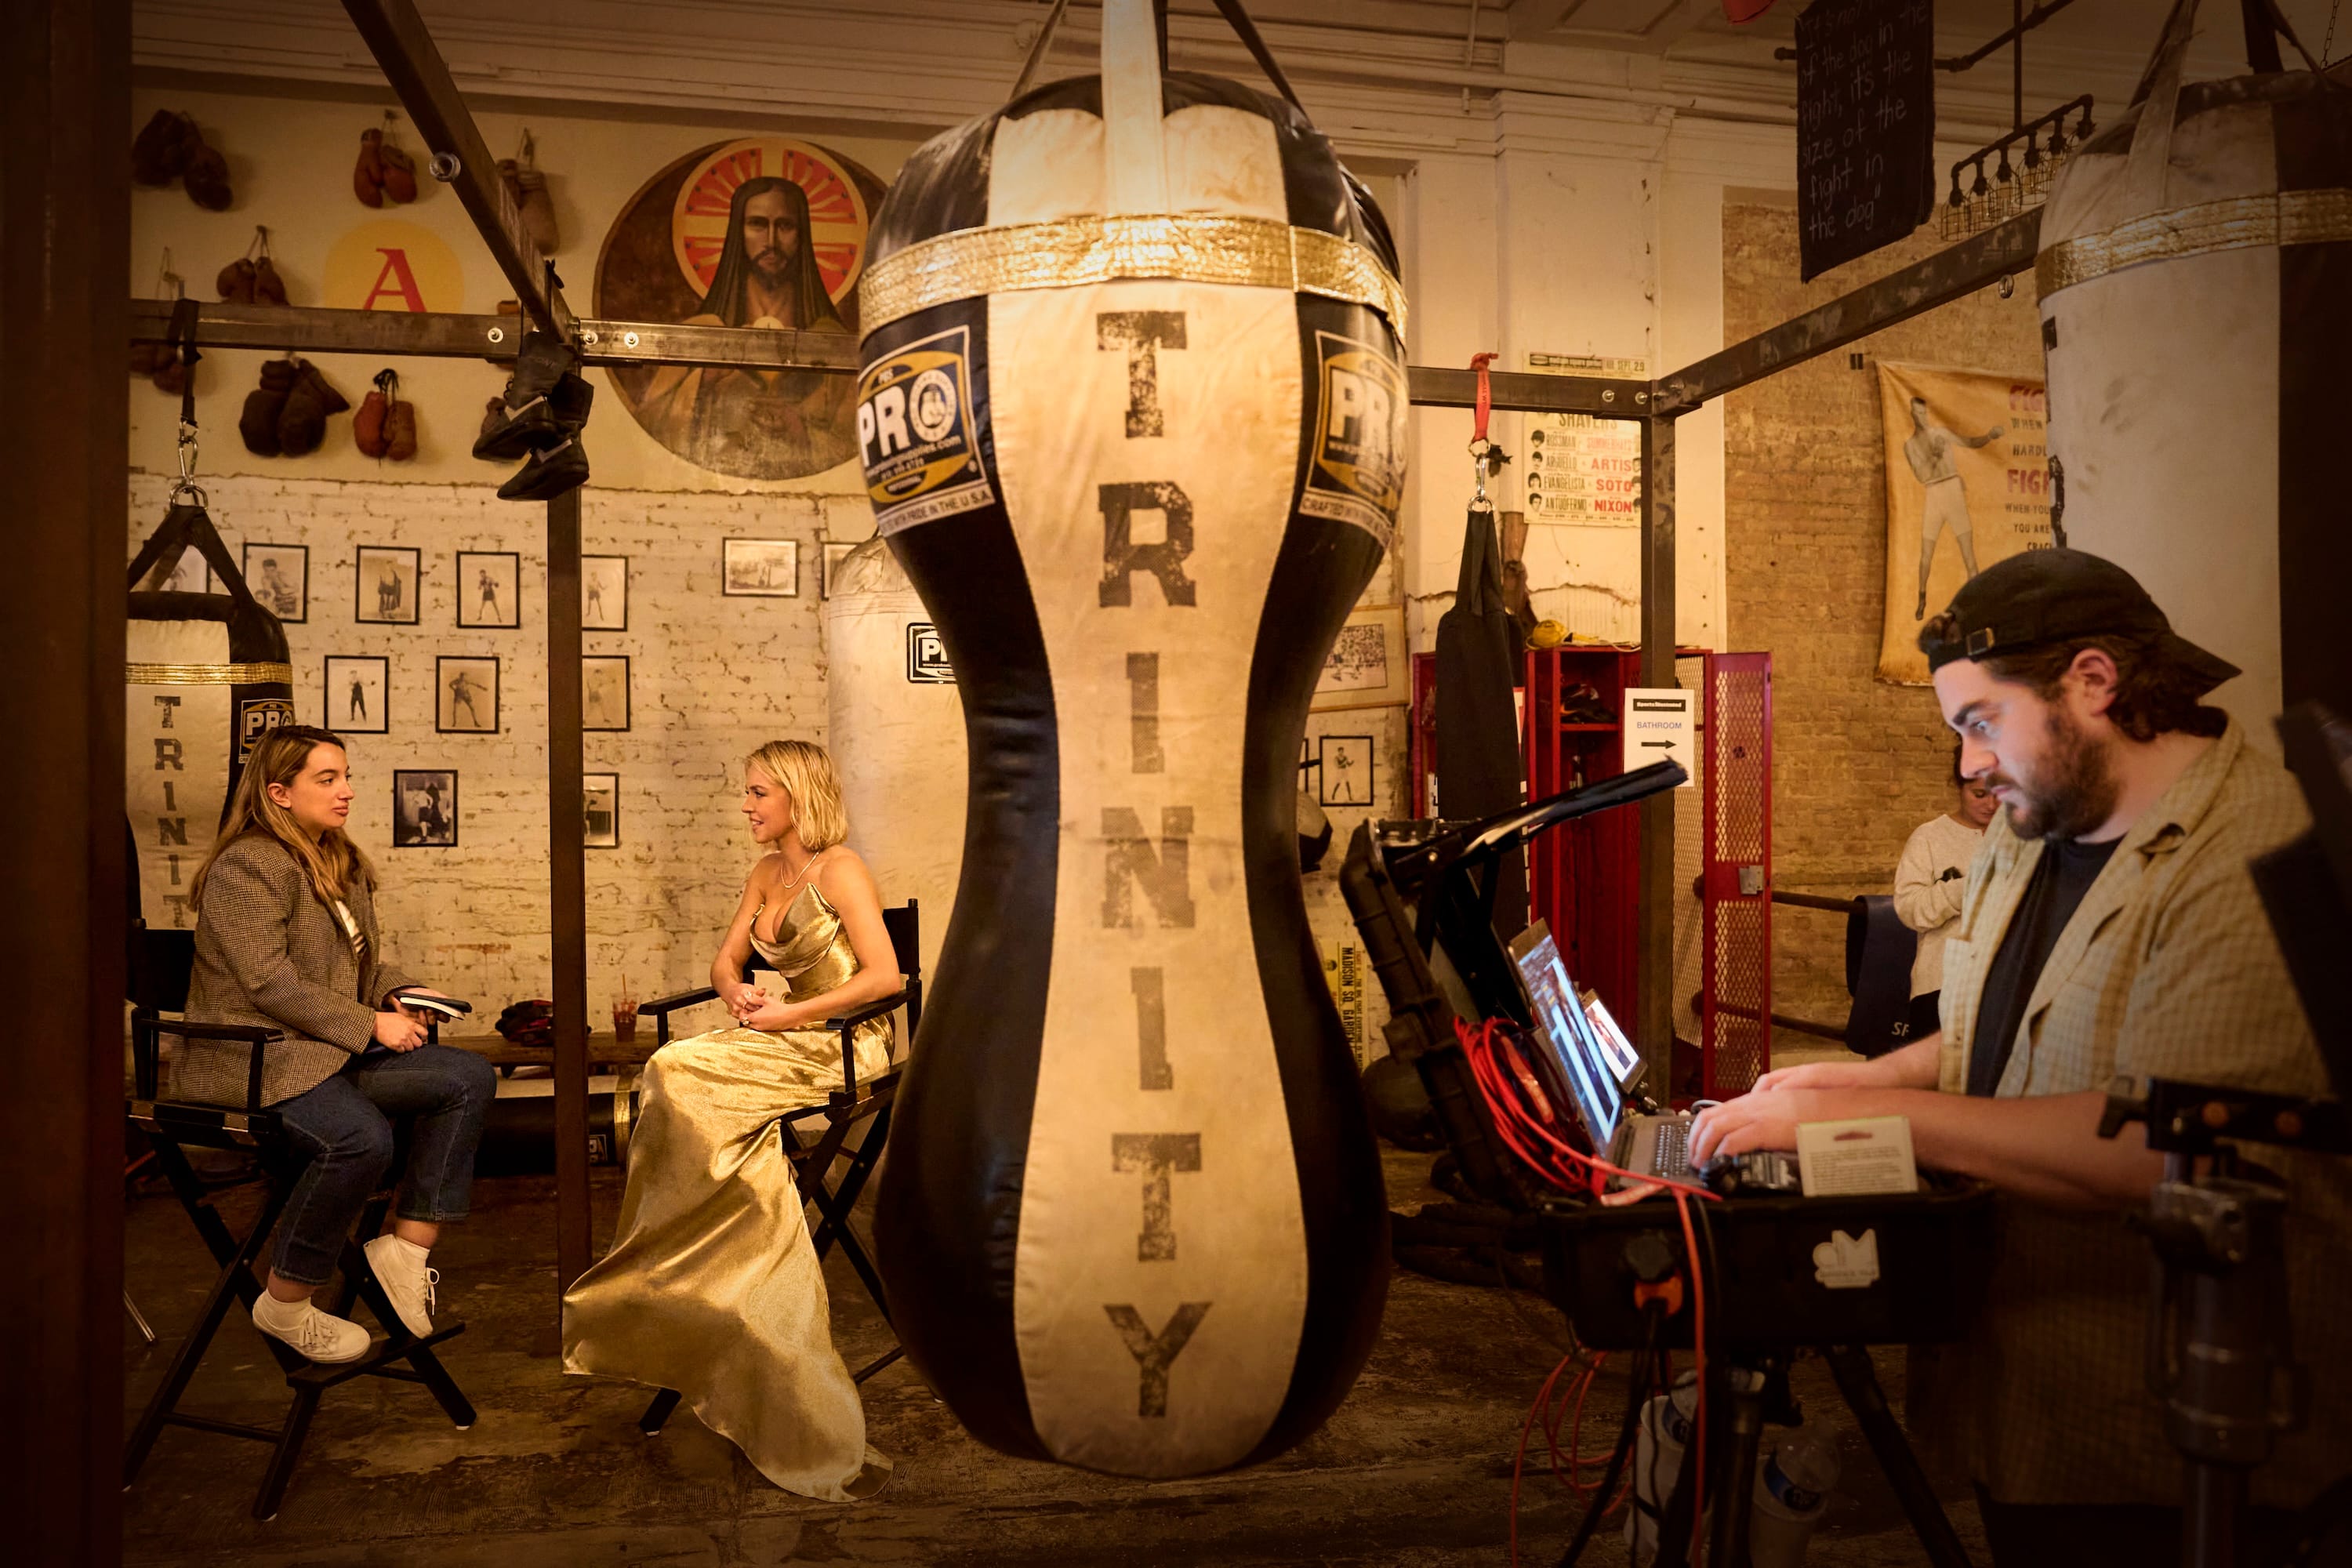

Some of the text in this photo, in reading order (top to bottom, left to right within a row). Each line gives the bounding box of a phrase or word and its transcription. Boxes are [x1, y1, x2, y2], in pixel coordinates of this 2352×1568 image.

[1822, 44, 1845, 78] the
[1849, 31, 1873, 66] dog
[1878, 19, 1893, 49] in
[1850, 63, 1875, 105] it's
[1882, 50, 1913, 85] the
[1802, 96, 1907, 169] size of the
[1809, 149, 1883, 212] fight in
[1808, 210, 1837, 242] the
[364, 248, 427, 312] A
[1634, 361, 1645, 372] 29
[2009, 384, 2045, 412] FIG
[858, 368, 957, 467] PRO
[2011, 418, 2043, 430] WHEN
[1592, 457, 1632, 472] ARTIS
[2013, 444, 2048, 457] HARDL
[1595, 478, 1632, 492] SOTO
[938, 499, 960, 513] THE
[1594, 499, 1632, 513] NIXON
[2013, 523, 2050, 534] YOU ARE
[1637, 721, 1682, 730] BATHROOM
[153, 695, 189, 928] TRINIT
[1096, 310, 1212, 1417] TRINITY
[1341, 947, 1355, 986] MADISON
